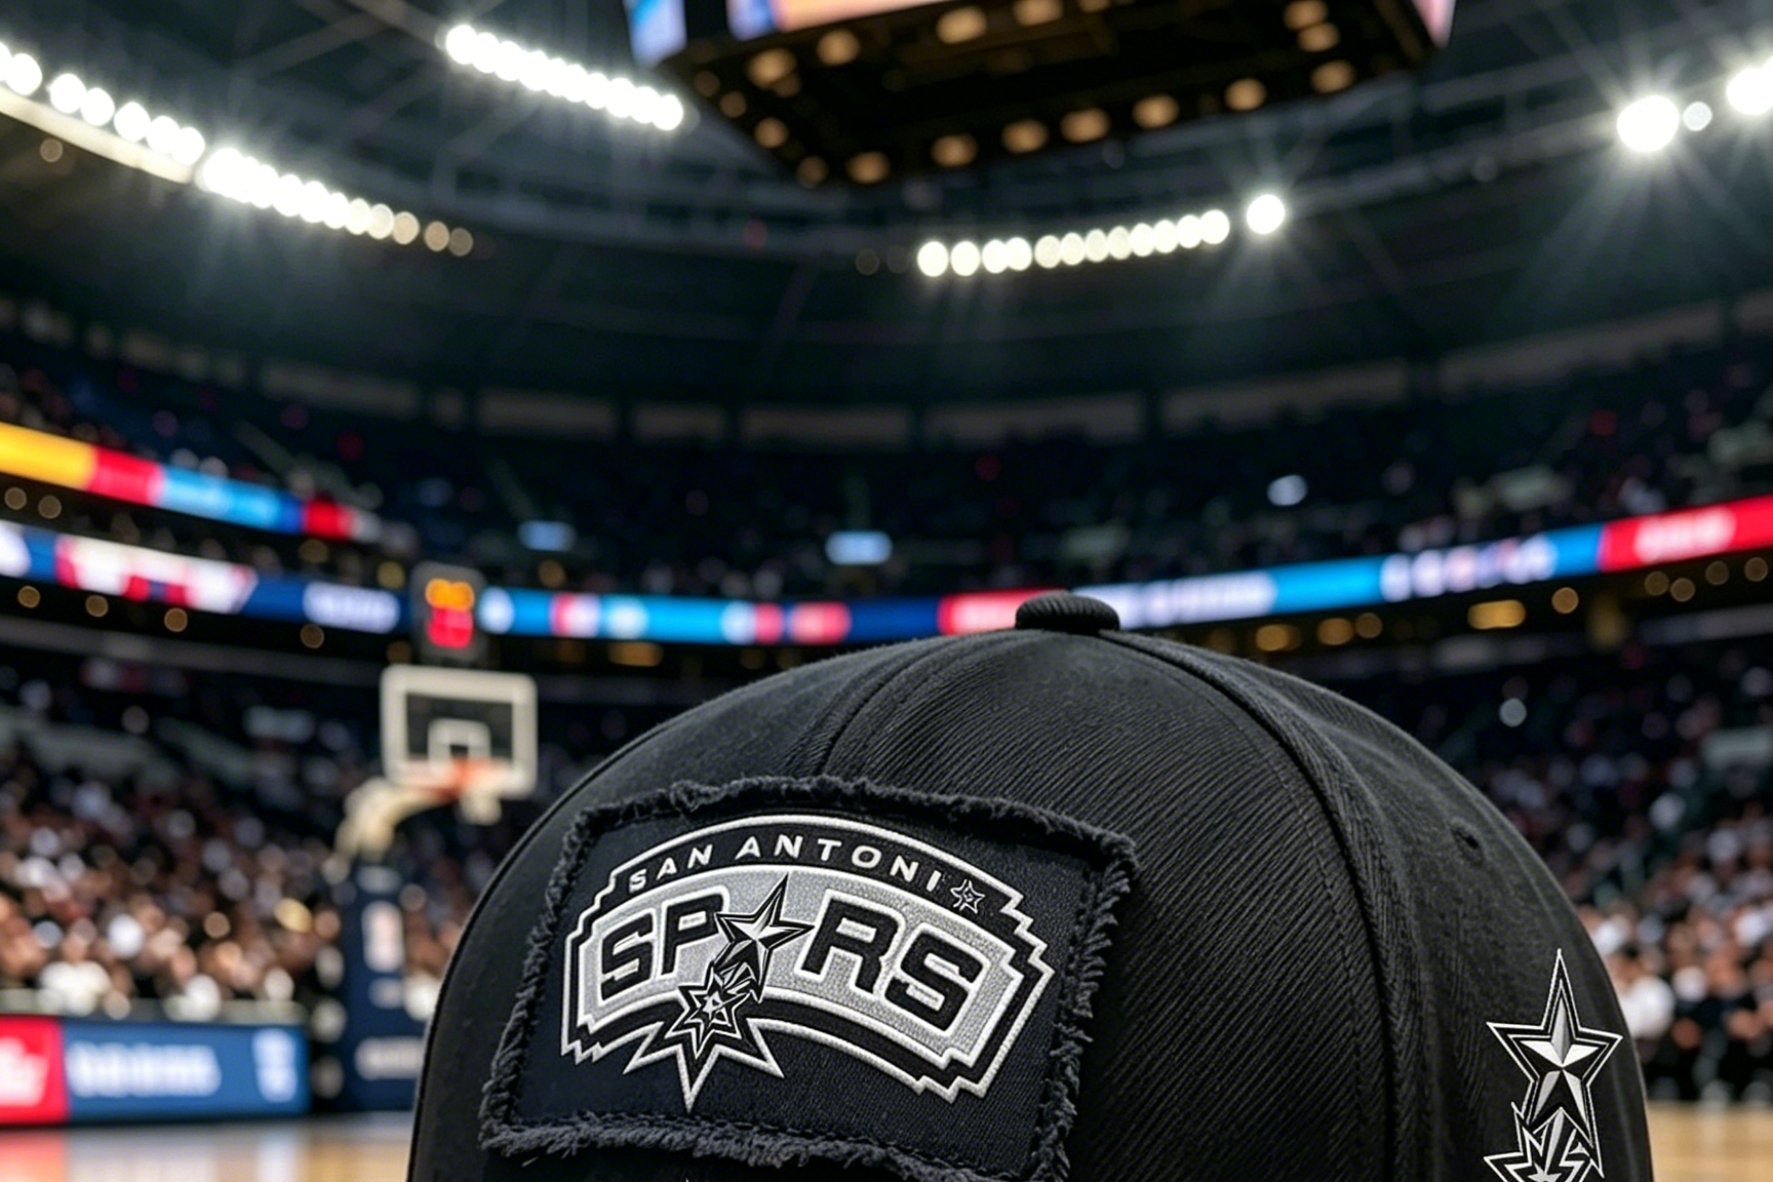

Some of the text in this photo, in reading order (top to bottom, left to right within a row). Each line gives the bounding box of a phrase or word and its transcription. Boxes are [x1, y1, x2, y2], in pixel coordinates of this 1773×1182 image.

[628, 834, 986, 914] SAN ANTONI
[597, 877, 989, 1037] SPRS
